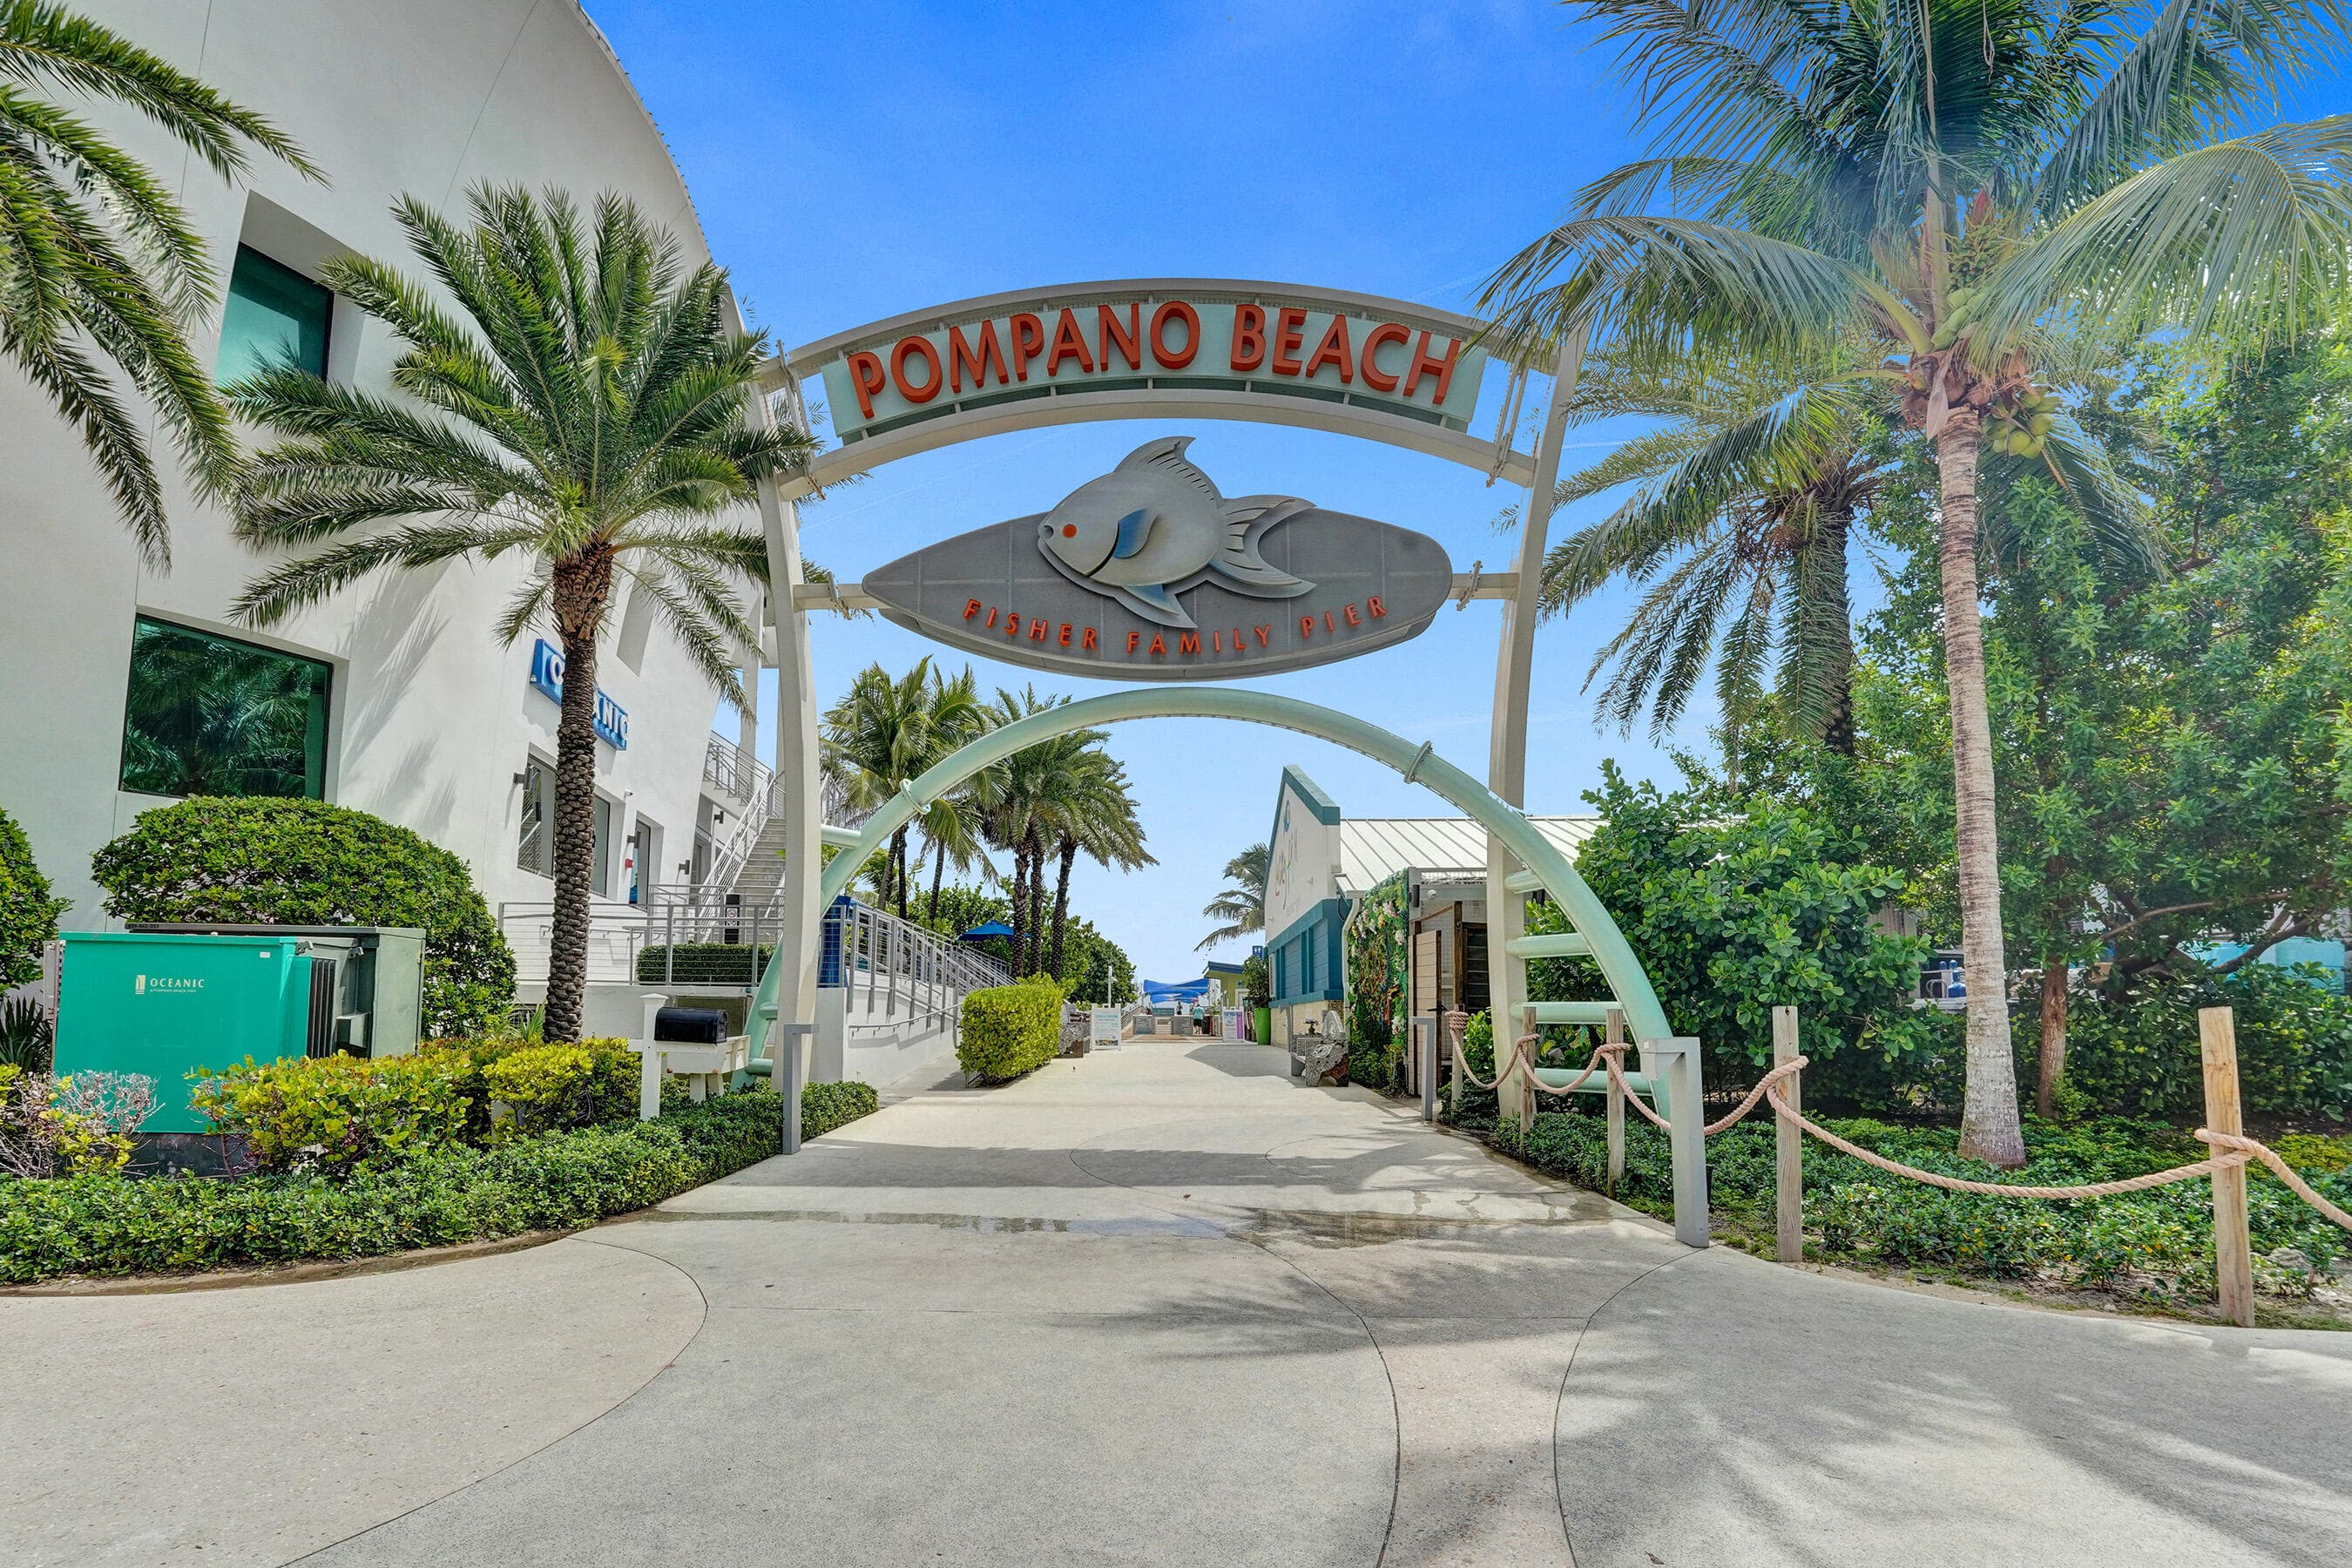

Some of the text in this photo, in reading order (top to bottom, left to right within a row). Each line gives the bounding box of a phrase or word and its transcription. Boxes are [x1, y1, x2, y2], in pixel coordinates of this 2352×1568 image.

[847, 301, 1462, 419] POMPANO BEACH
[963, 595, 1388, 656] FISHER FAMILY PIER
[150, 977, 206, 989] OCEANIC
